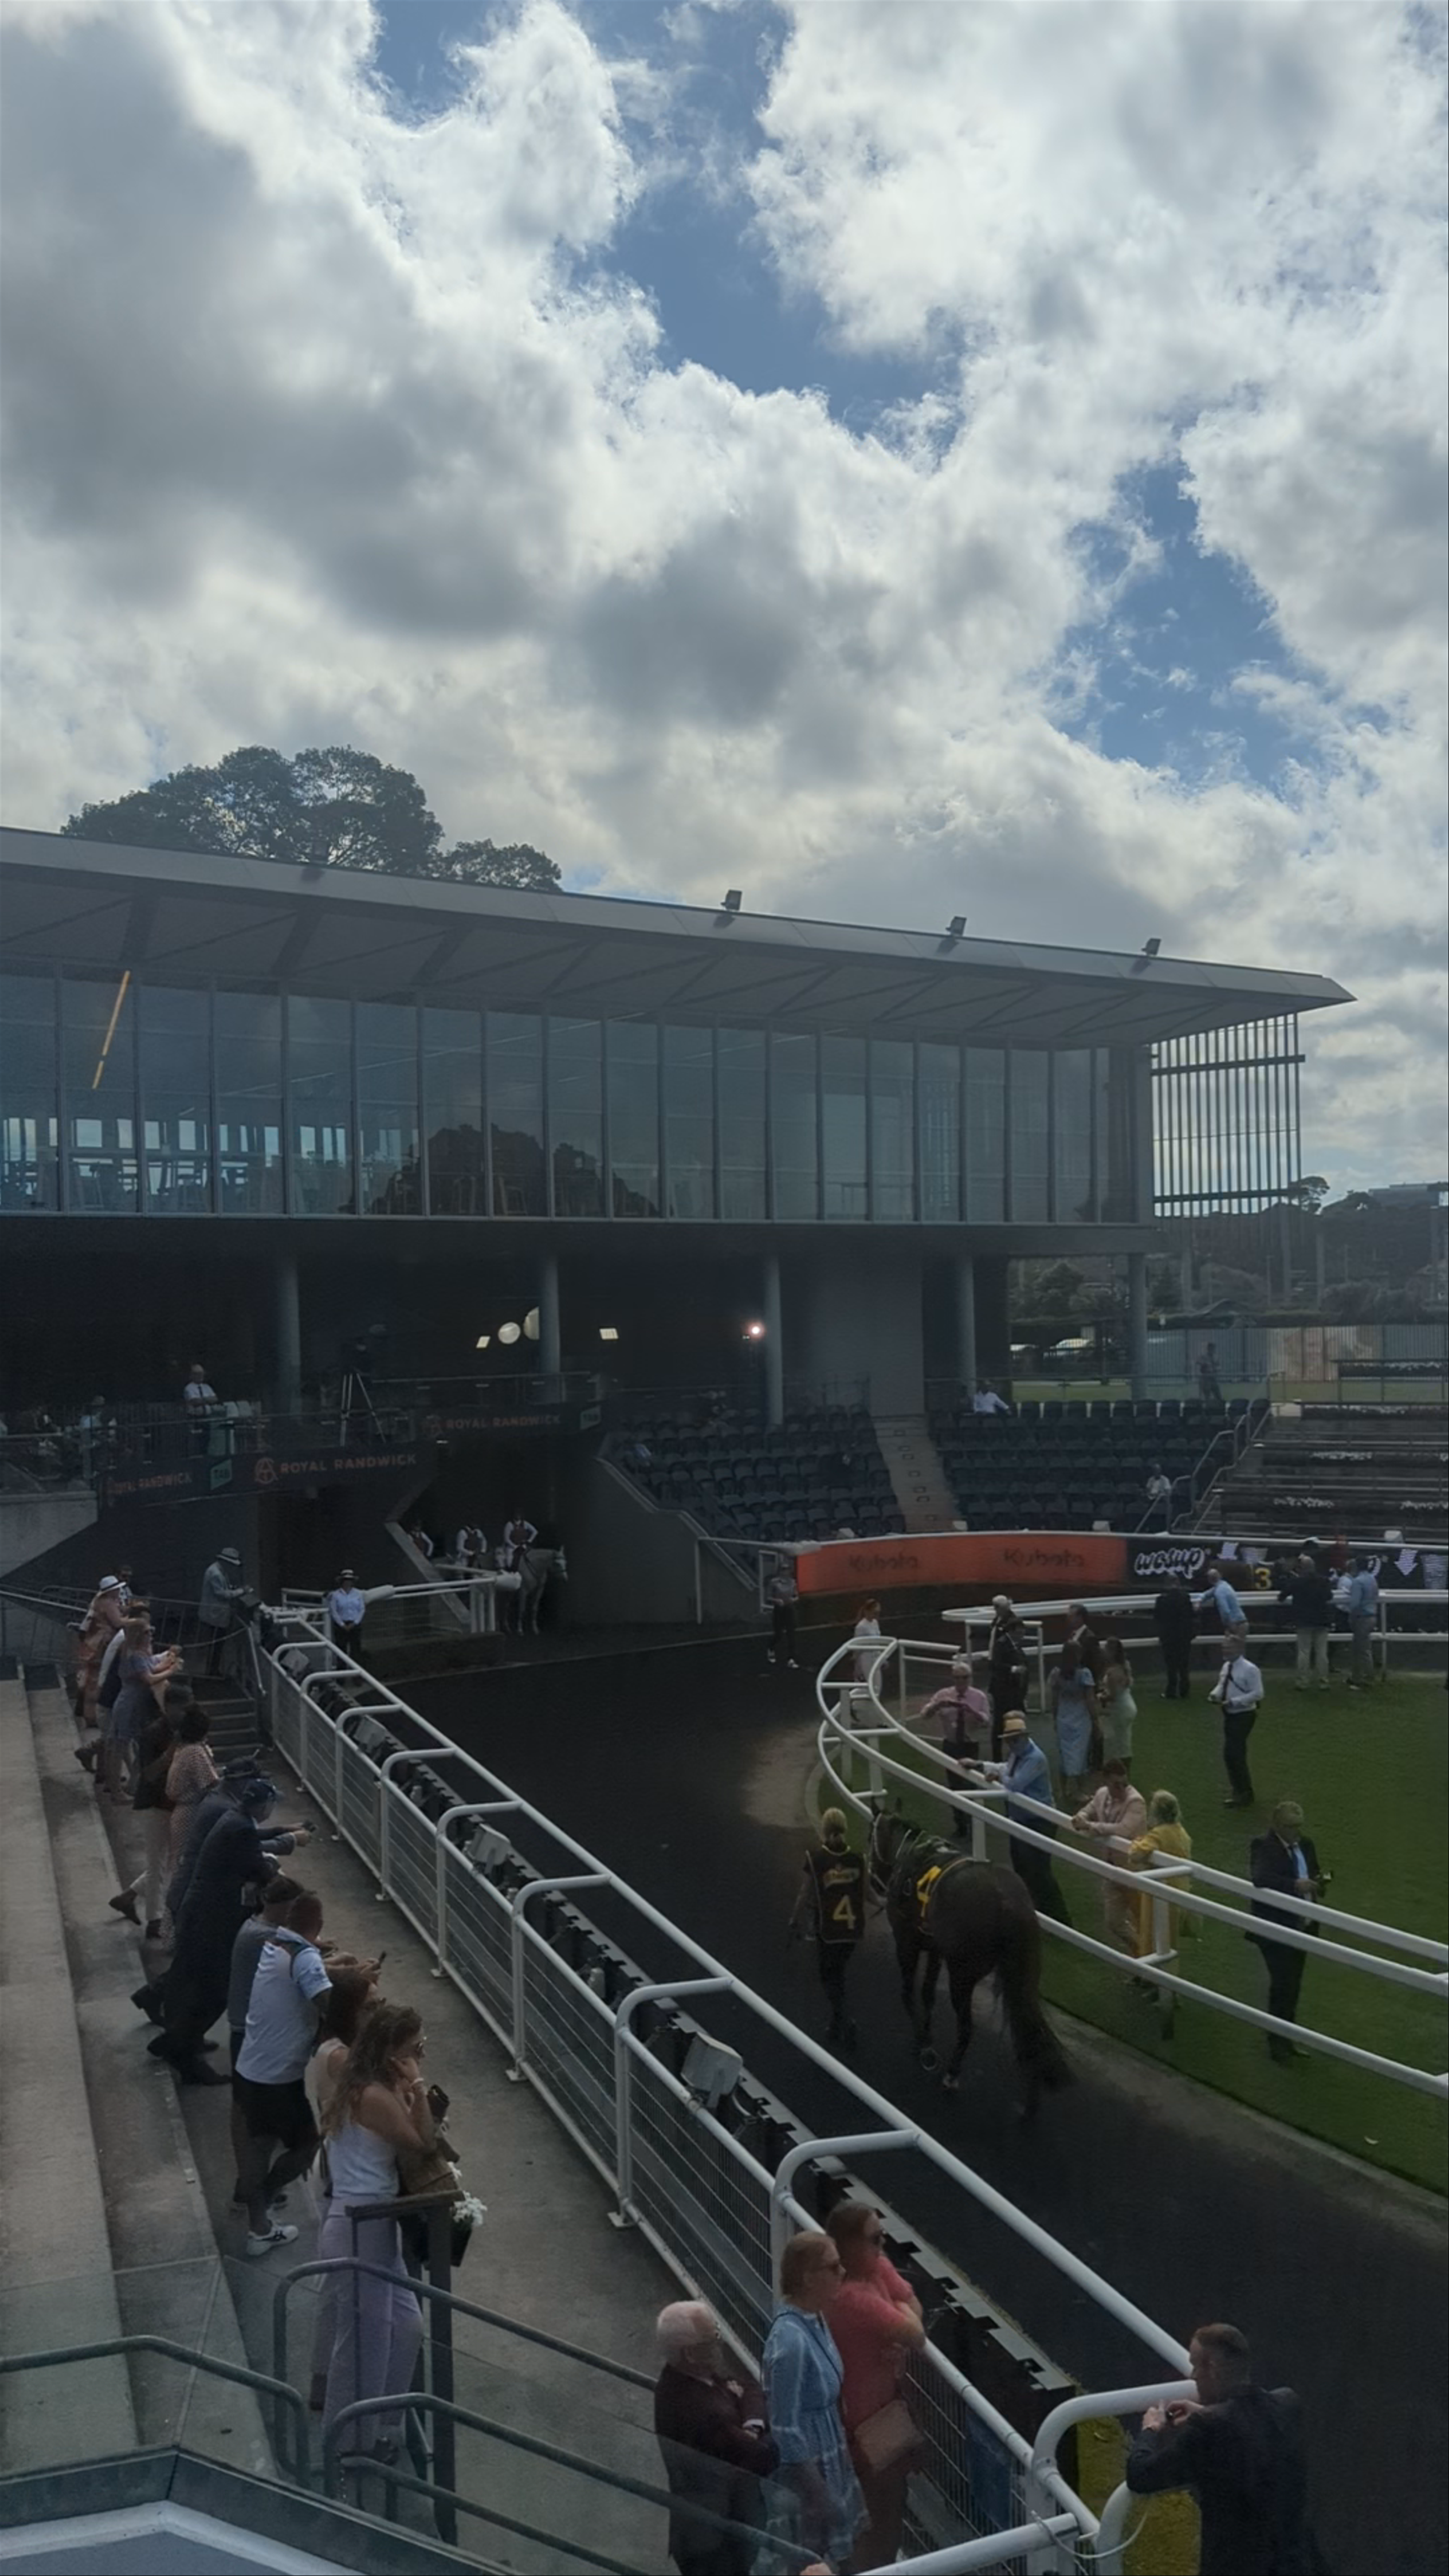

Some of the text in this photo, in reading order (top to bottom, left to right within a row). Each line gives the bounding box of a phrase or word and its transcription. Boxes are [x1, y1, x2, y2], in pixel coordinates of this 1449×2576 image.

[492, 1414, 561, 1428] RANDWICK
[280, 1461, 328, 1473] ROYAL
[334, 1453, 417, 1470] RANDWICK
[849, 1552, 918, 1570] Kubota
[1004, 1548, 1085, 1567] Kubota
[1254, 1567, 1272, 1590] 3
[832, 1894, 856, 1930] 4
